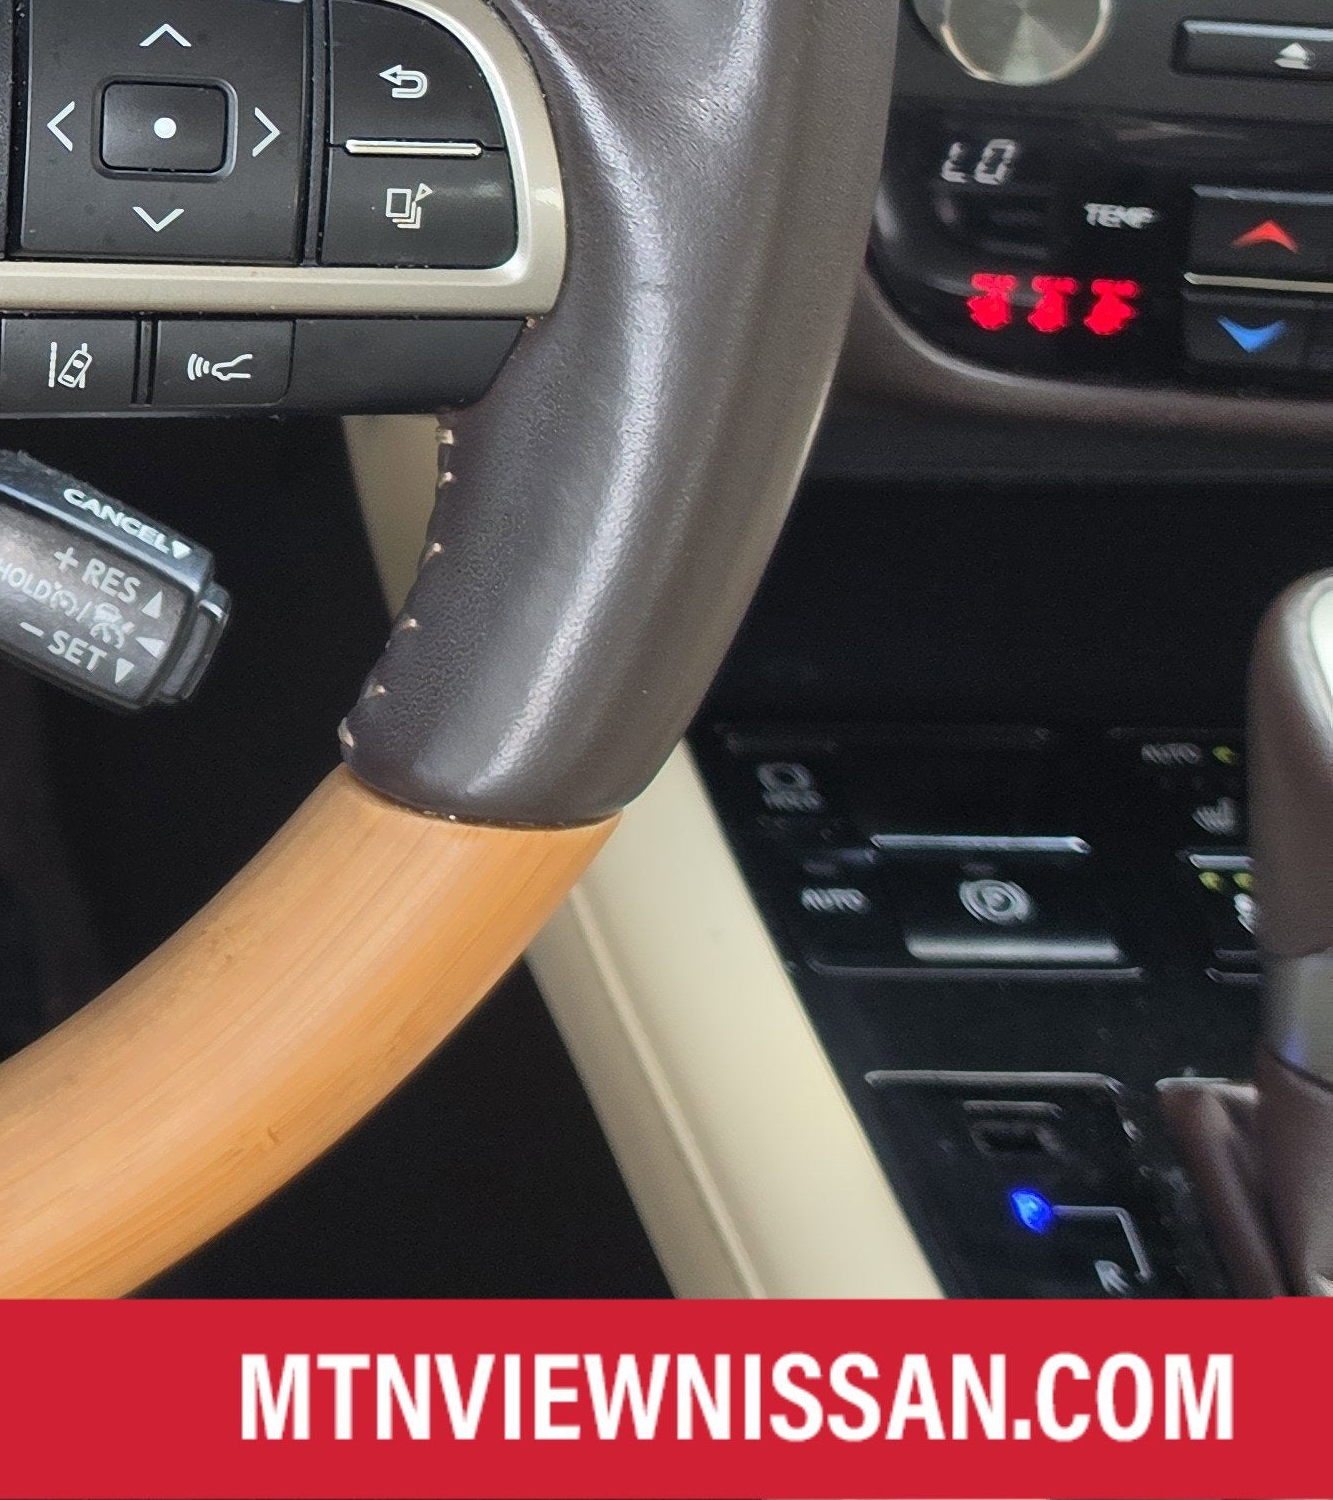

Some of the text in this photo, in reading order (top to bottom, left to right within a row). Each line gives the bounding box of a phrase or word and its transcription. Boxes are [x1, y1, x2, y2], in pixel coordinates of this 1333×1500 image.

[63, 488, 170, 554] CANCEL
[82, 557, 141, 604] RES
[47, 629, 108, 672] SET
